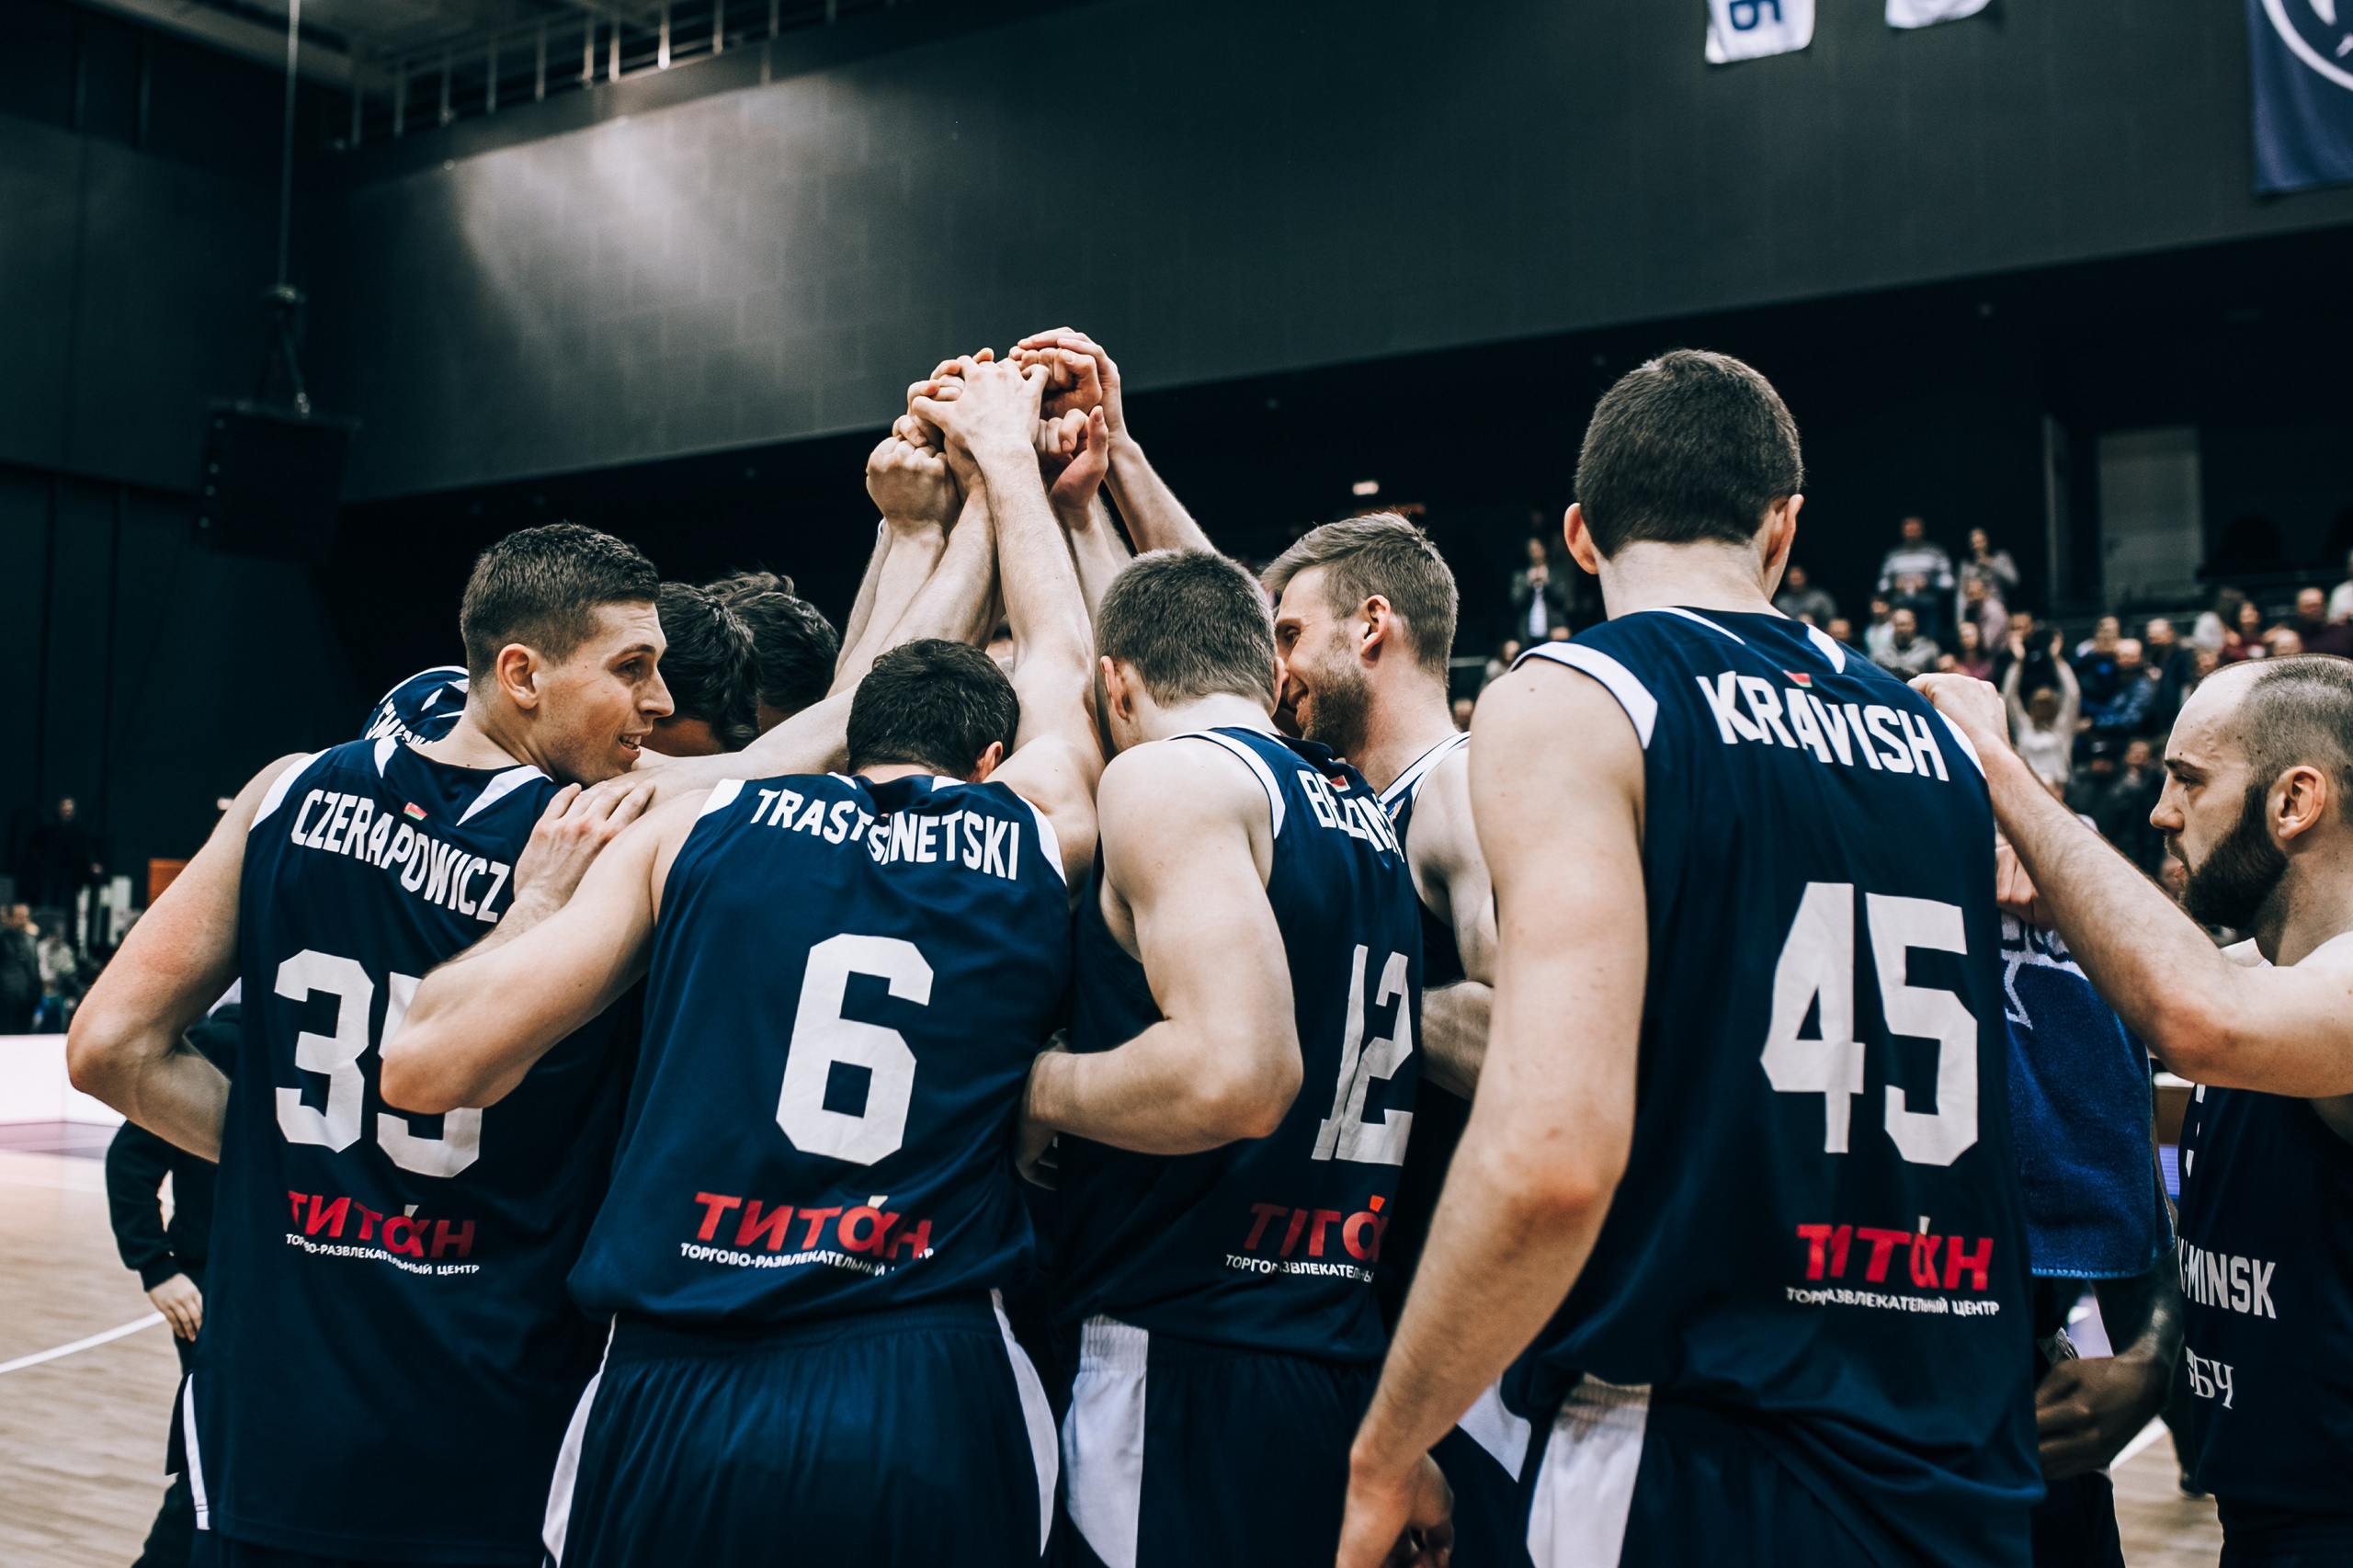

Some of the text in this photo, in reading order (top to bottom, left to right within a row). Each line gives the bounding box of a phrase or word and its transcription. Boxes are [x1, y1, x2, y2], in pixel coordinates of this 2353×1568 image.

[1696, 671, 1949, 781] KRAVISH
[290, 789, 511, 923] CZERAPOWICZ
[776, 933, 934, 1166] 6
[1312, 944, 1413, 1165] 12
[1759, 881, 1978, 1166] 45
[437, 1265, 480, 1276] ЦЕНТР
[1951, 1300, 2000, 1317] ЦЕНТР
